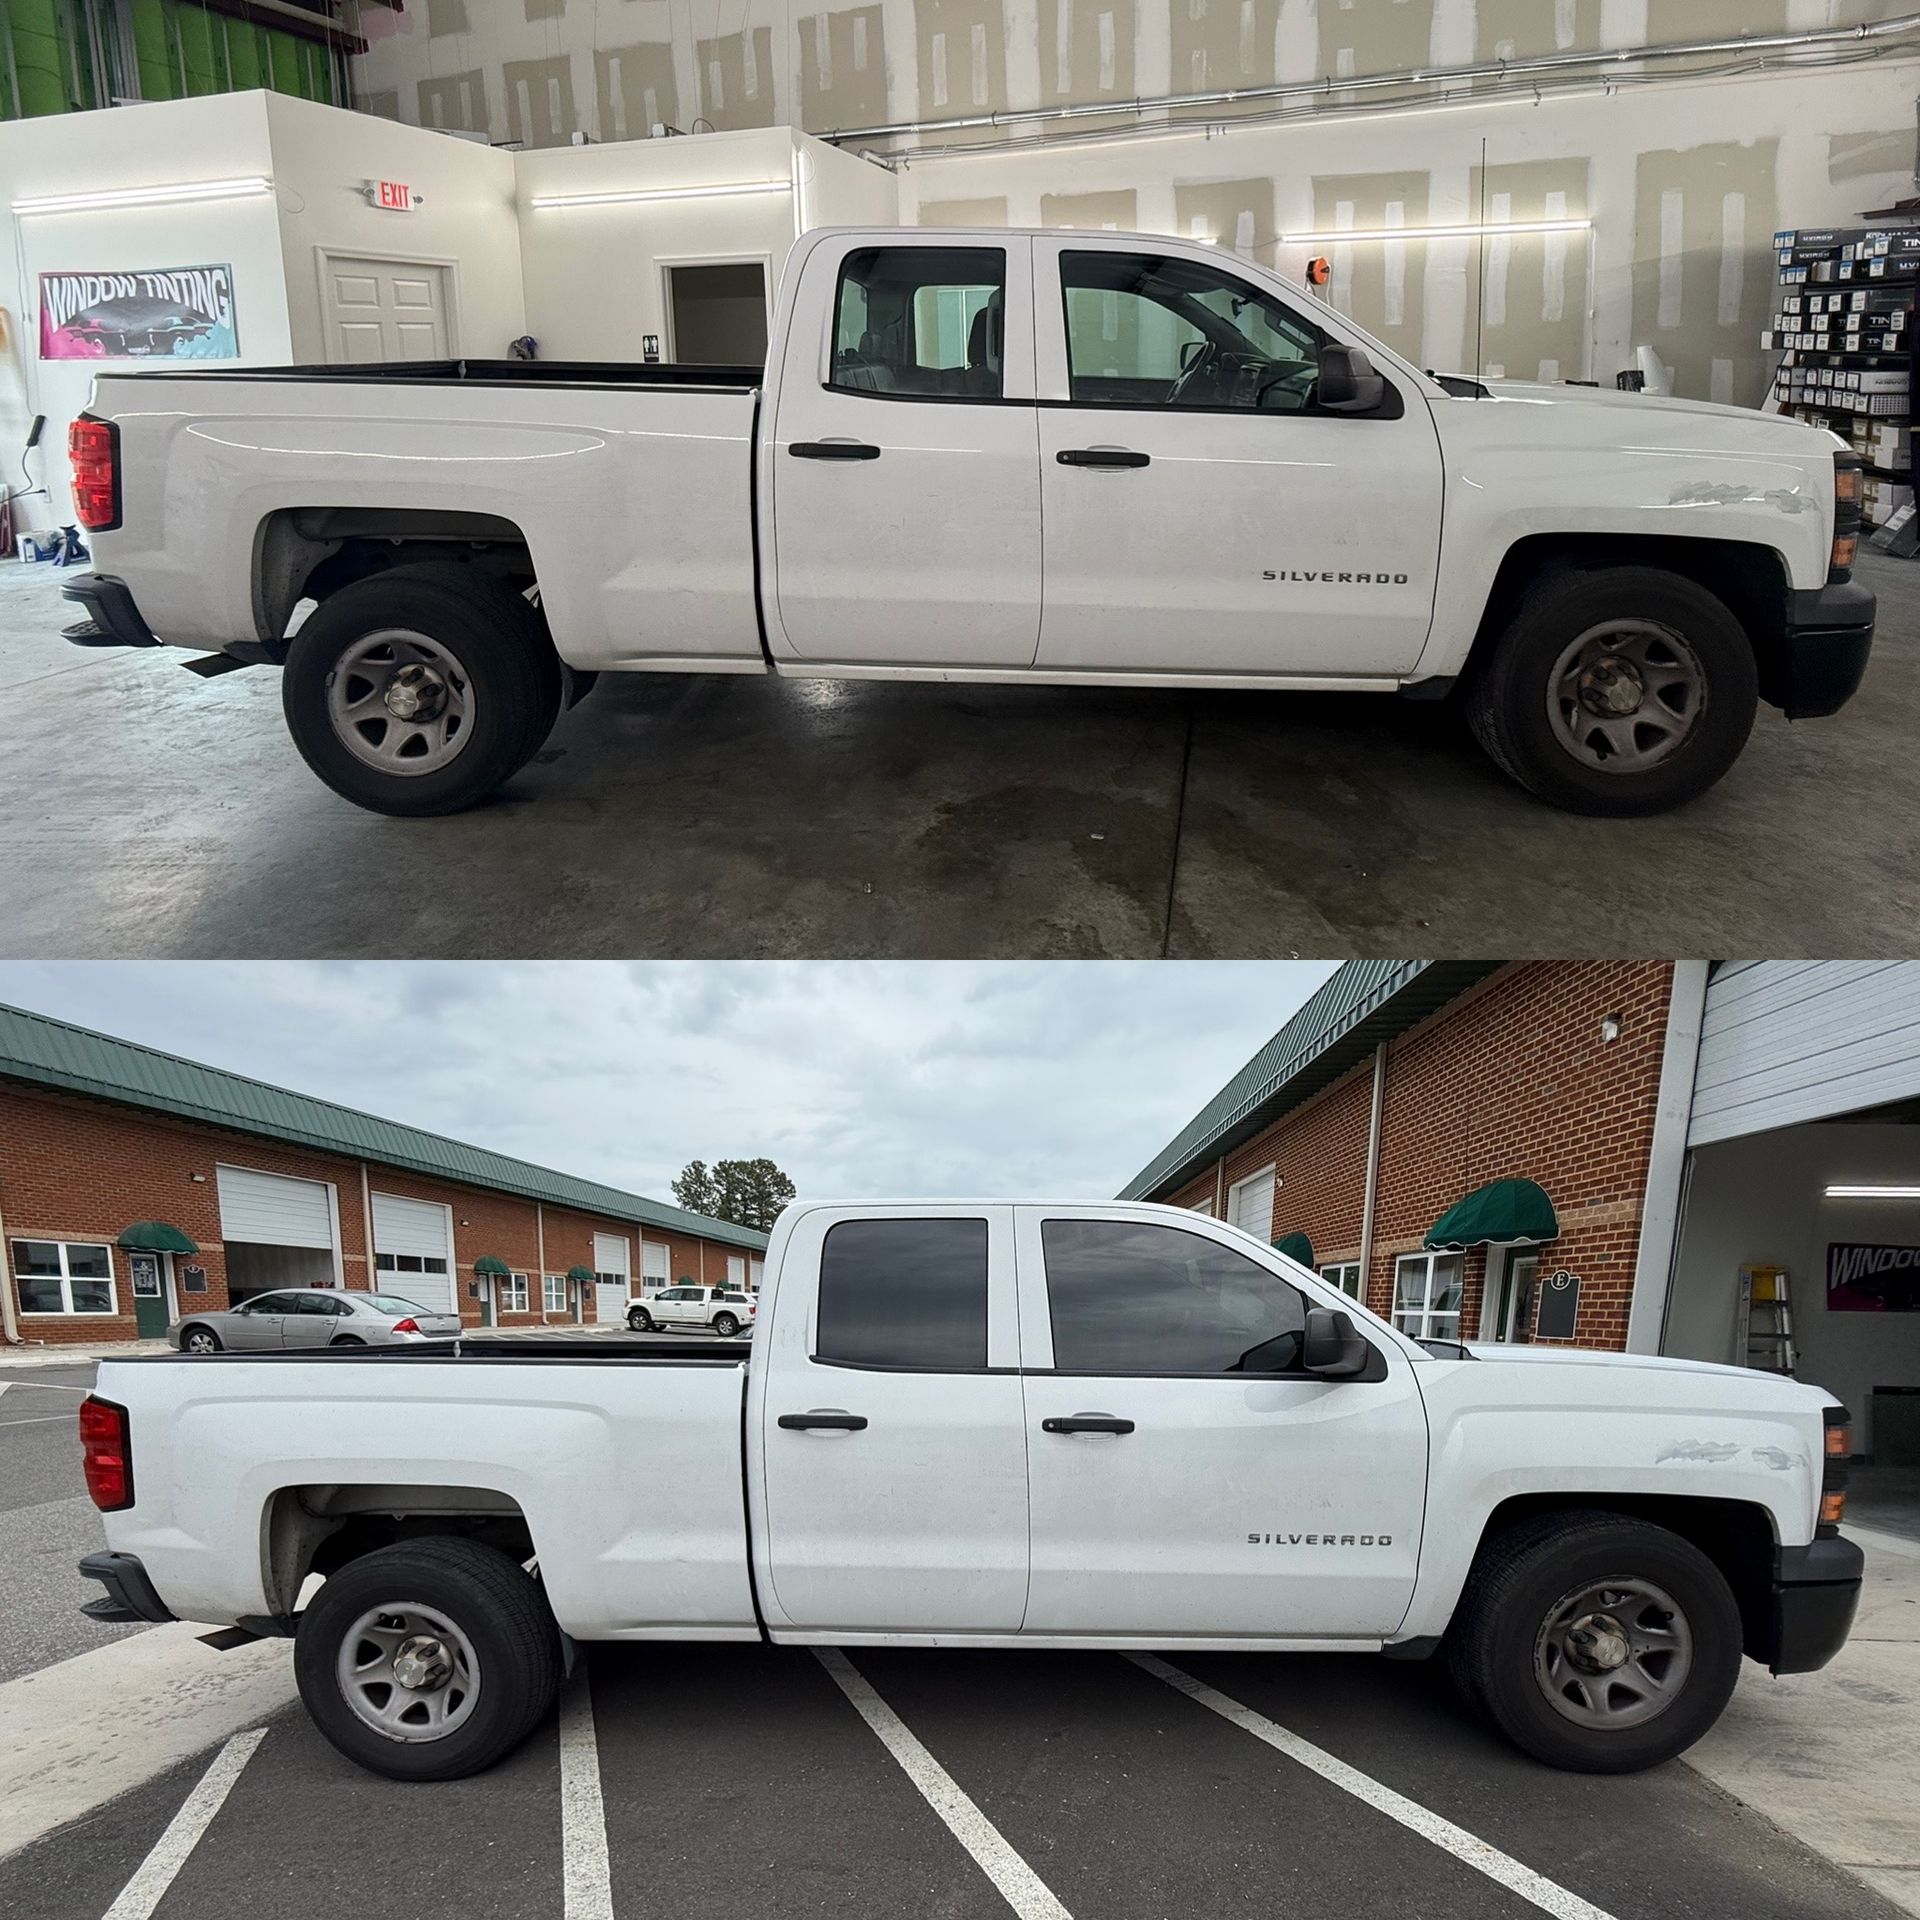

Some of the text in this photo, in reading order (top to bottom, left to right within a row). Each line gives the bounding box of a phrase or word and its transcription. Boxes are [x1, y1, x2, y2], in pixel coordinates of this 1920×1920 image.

[381, 181, 409, 208] EXIT
[44, 269, 230, 333] WINDOW TINTING
[1262, 570, 1408, 585] SILVERADO
[1555, 1273, 1565, 1287] E
[1247, 1533, 1392, 1546] SILVERADO
